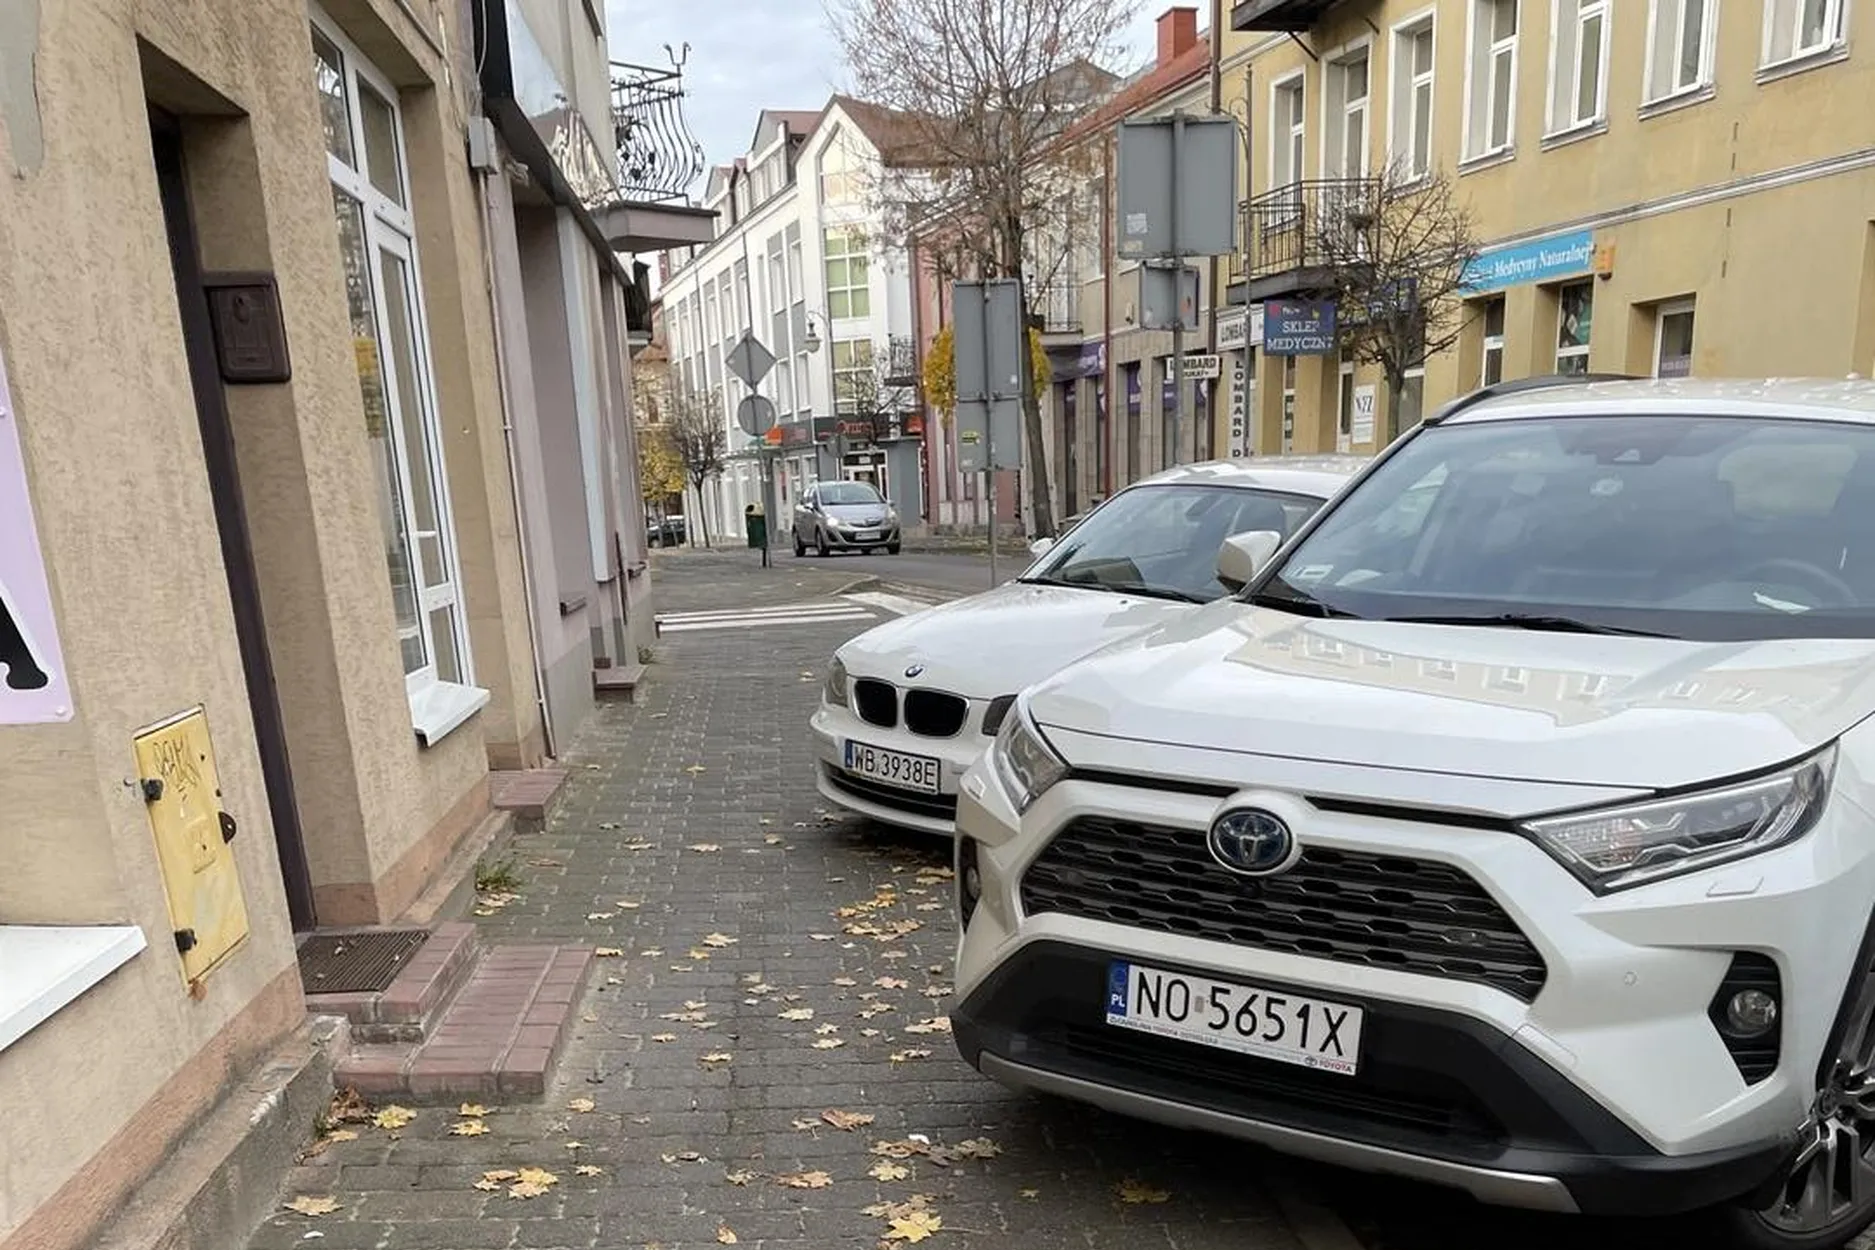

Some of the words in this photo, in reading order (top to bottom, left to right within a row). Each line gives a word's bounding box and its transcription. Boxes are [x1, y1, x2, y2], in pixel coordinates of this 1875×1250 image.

[1282, 321, 1320, 333] SKLEP
[1267, 336, 1334, 351] MEDYCZNY
[1232, 361, 1244, 437] LOMBARD
[855, 746, 875, 772] WB
[881, 754, 936, 786] 3938E
[1111, 994, 1126, 1008] PL
[1136, 971, 1191, 1022] NO
[1207, 986, 1348, 1056] 5651X
[1320, 1060, 1352, 1073] TOYOTA
